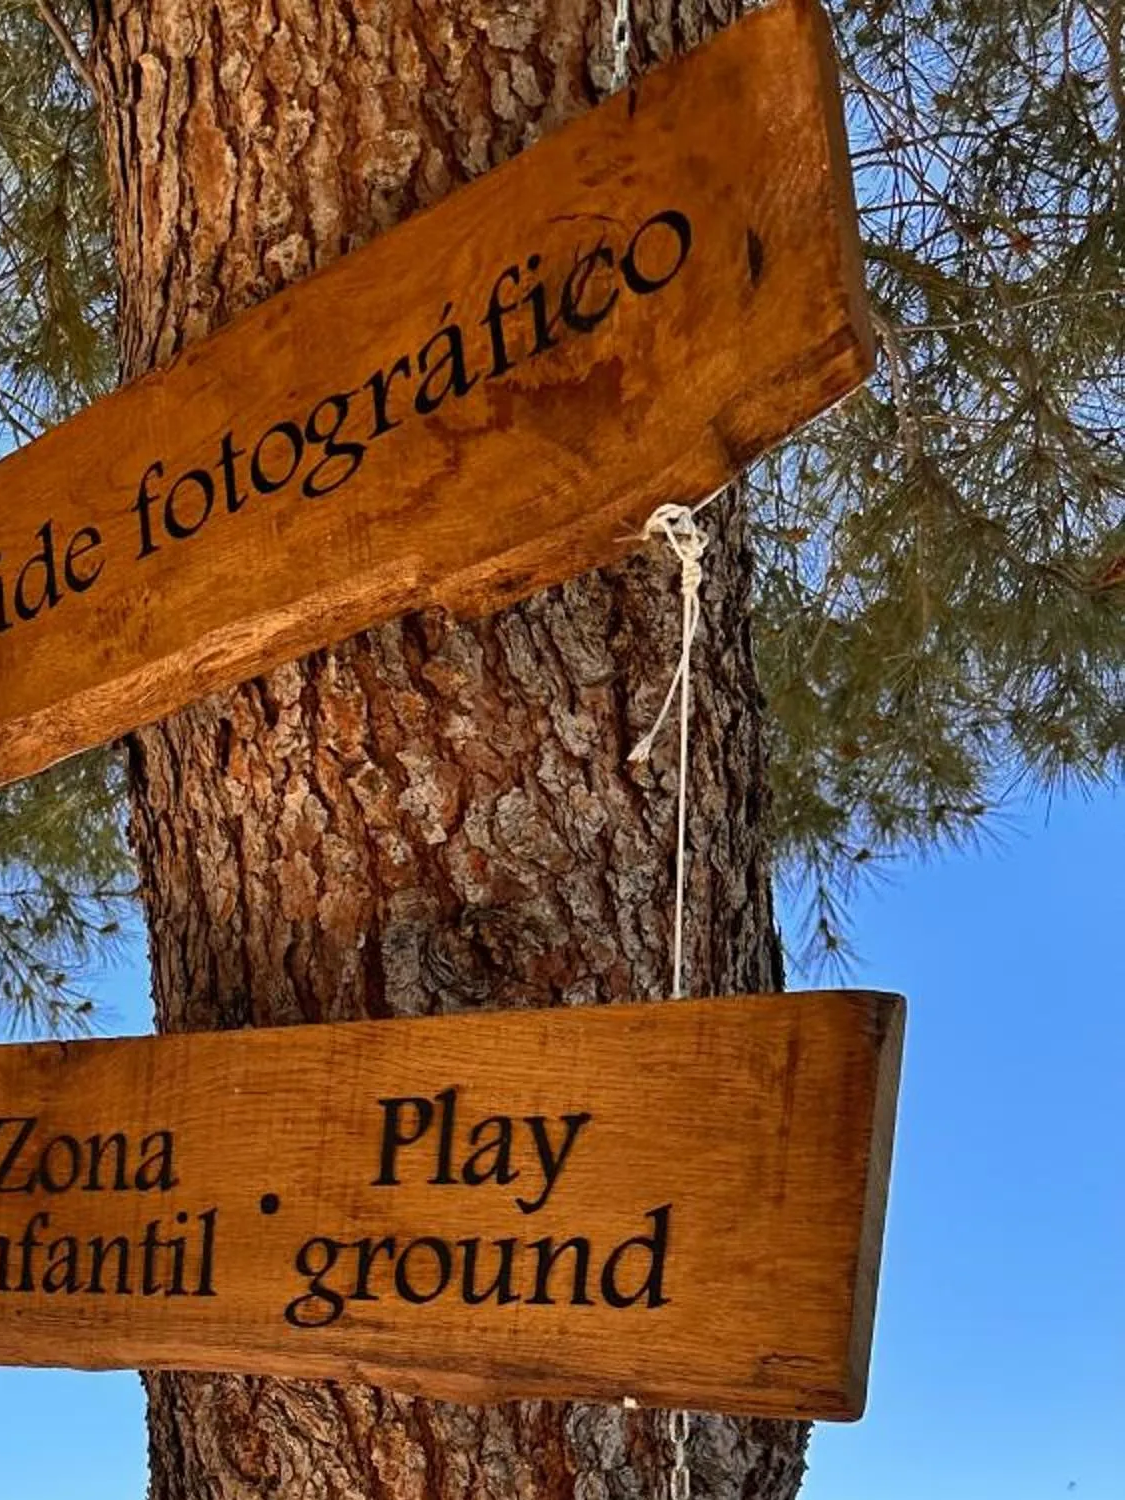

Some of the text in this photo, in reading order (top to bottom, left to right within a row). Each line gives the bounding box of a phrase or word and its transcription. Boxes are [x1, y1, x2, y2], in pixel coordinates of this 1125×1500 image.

[133, 210, 691, 557] fotográfico
[371, 1087, 590, 1212] Play
[285, 1204, 671, 1328] ground
